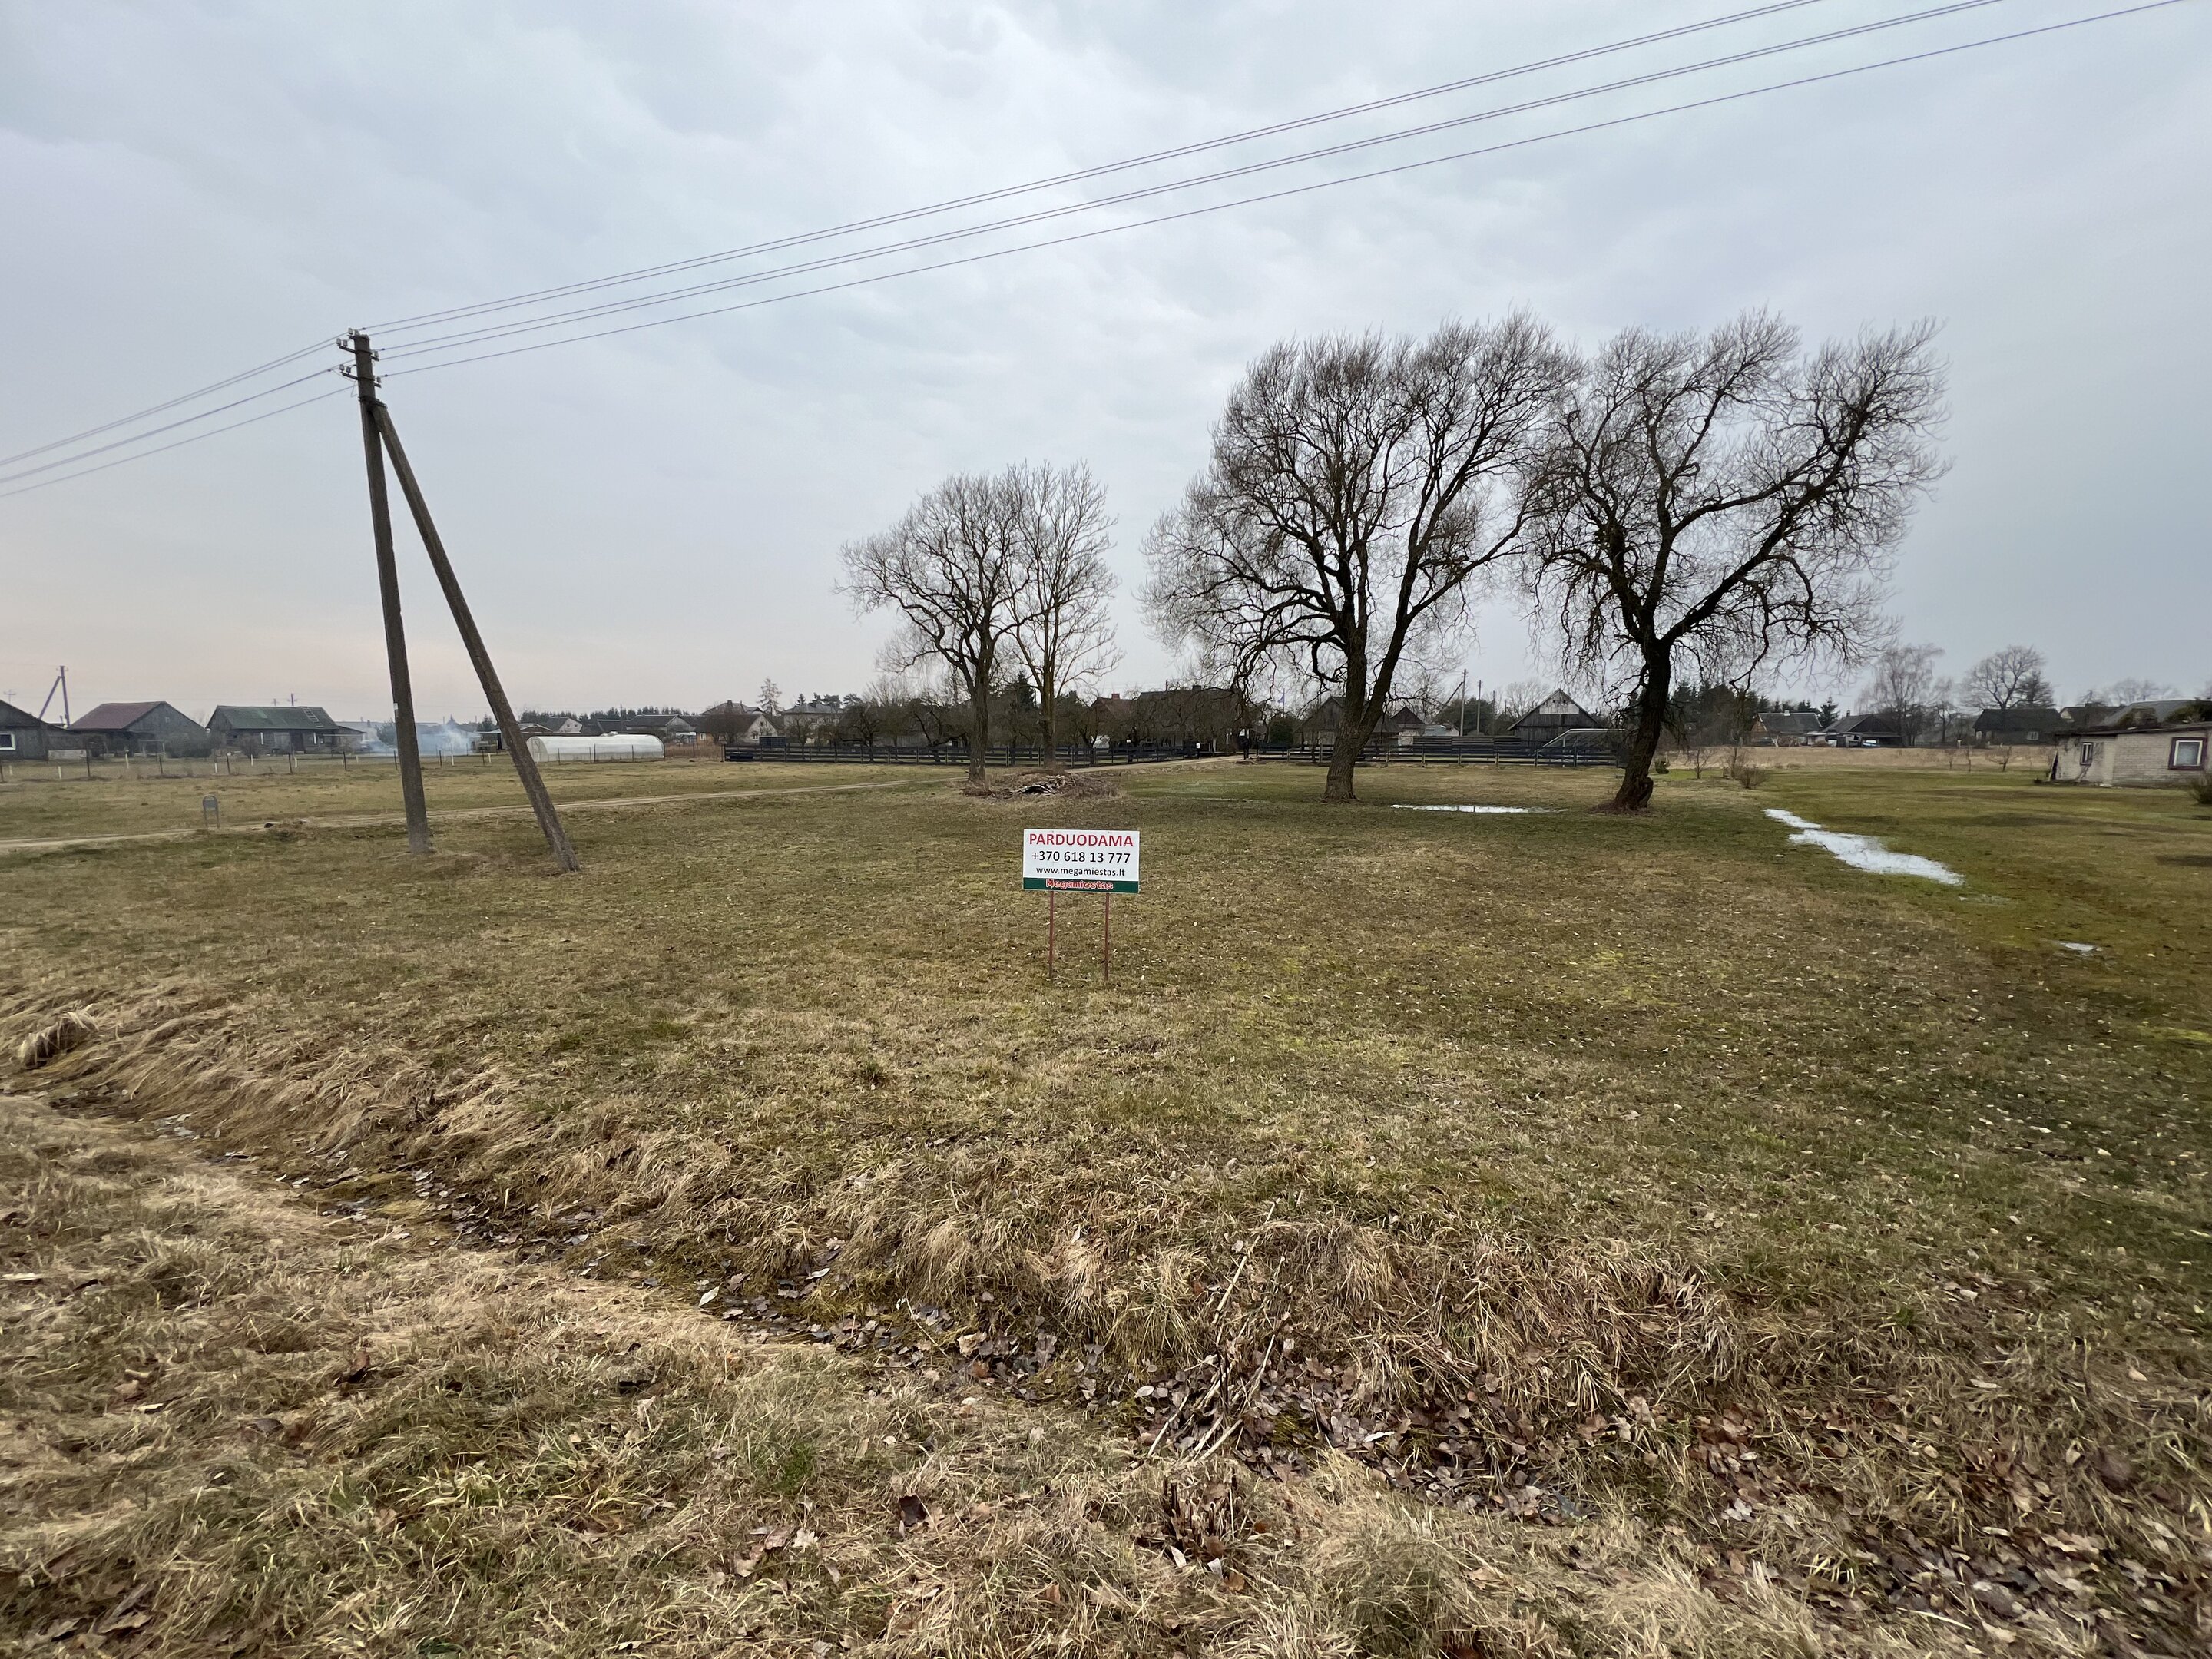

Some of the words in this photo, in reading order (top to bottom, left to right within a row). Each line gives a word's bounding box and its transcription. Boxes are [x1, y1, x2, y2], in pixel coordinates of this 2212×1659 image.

[1029, 833, 1134, 847] PARDUODAMA
[1031, 850, 1060, 861] +370
[1064, 852, 1085, 862] 618
[1090, 853, 1104, 863] 13
[1108, 853, 1131, 863] 777
[1036, 866, 1125, 876] www.megamiestas.lt
[1046, 879, 1113, 890] Megamiestas
